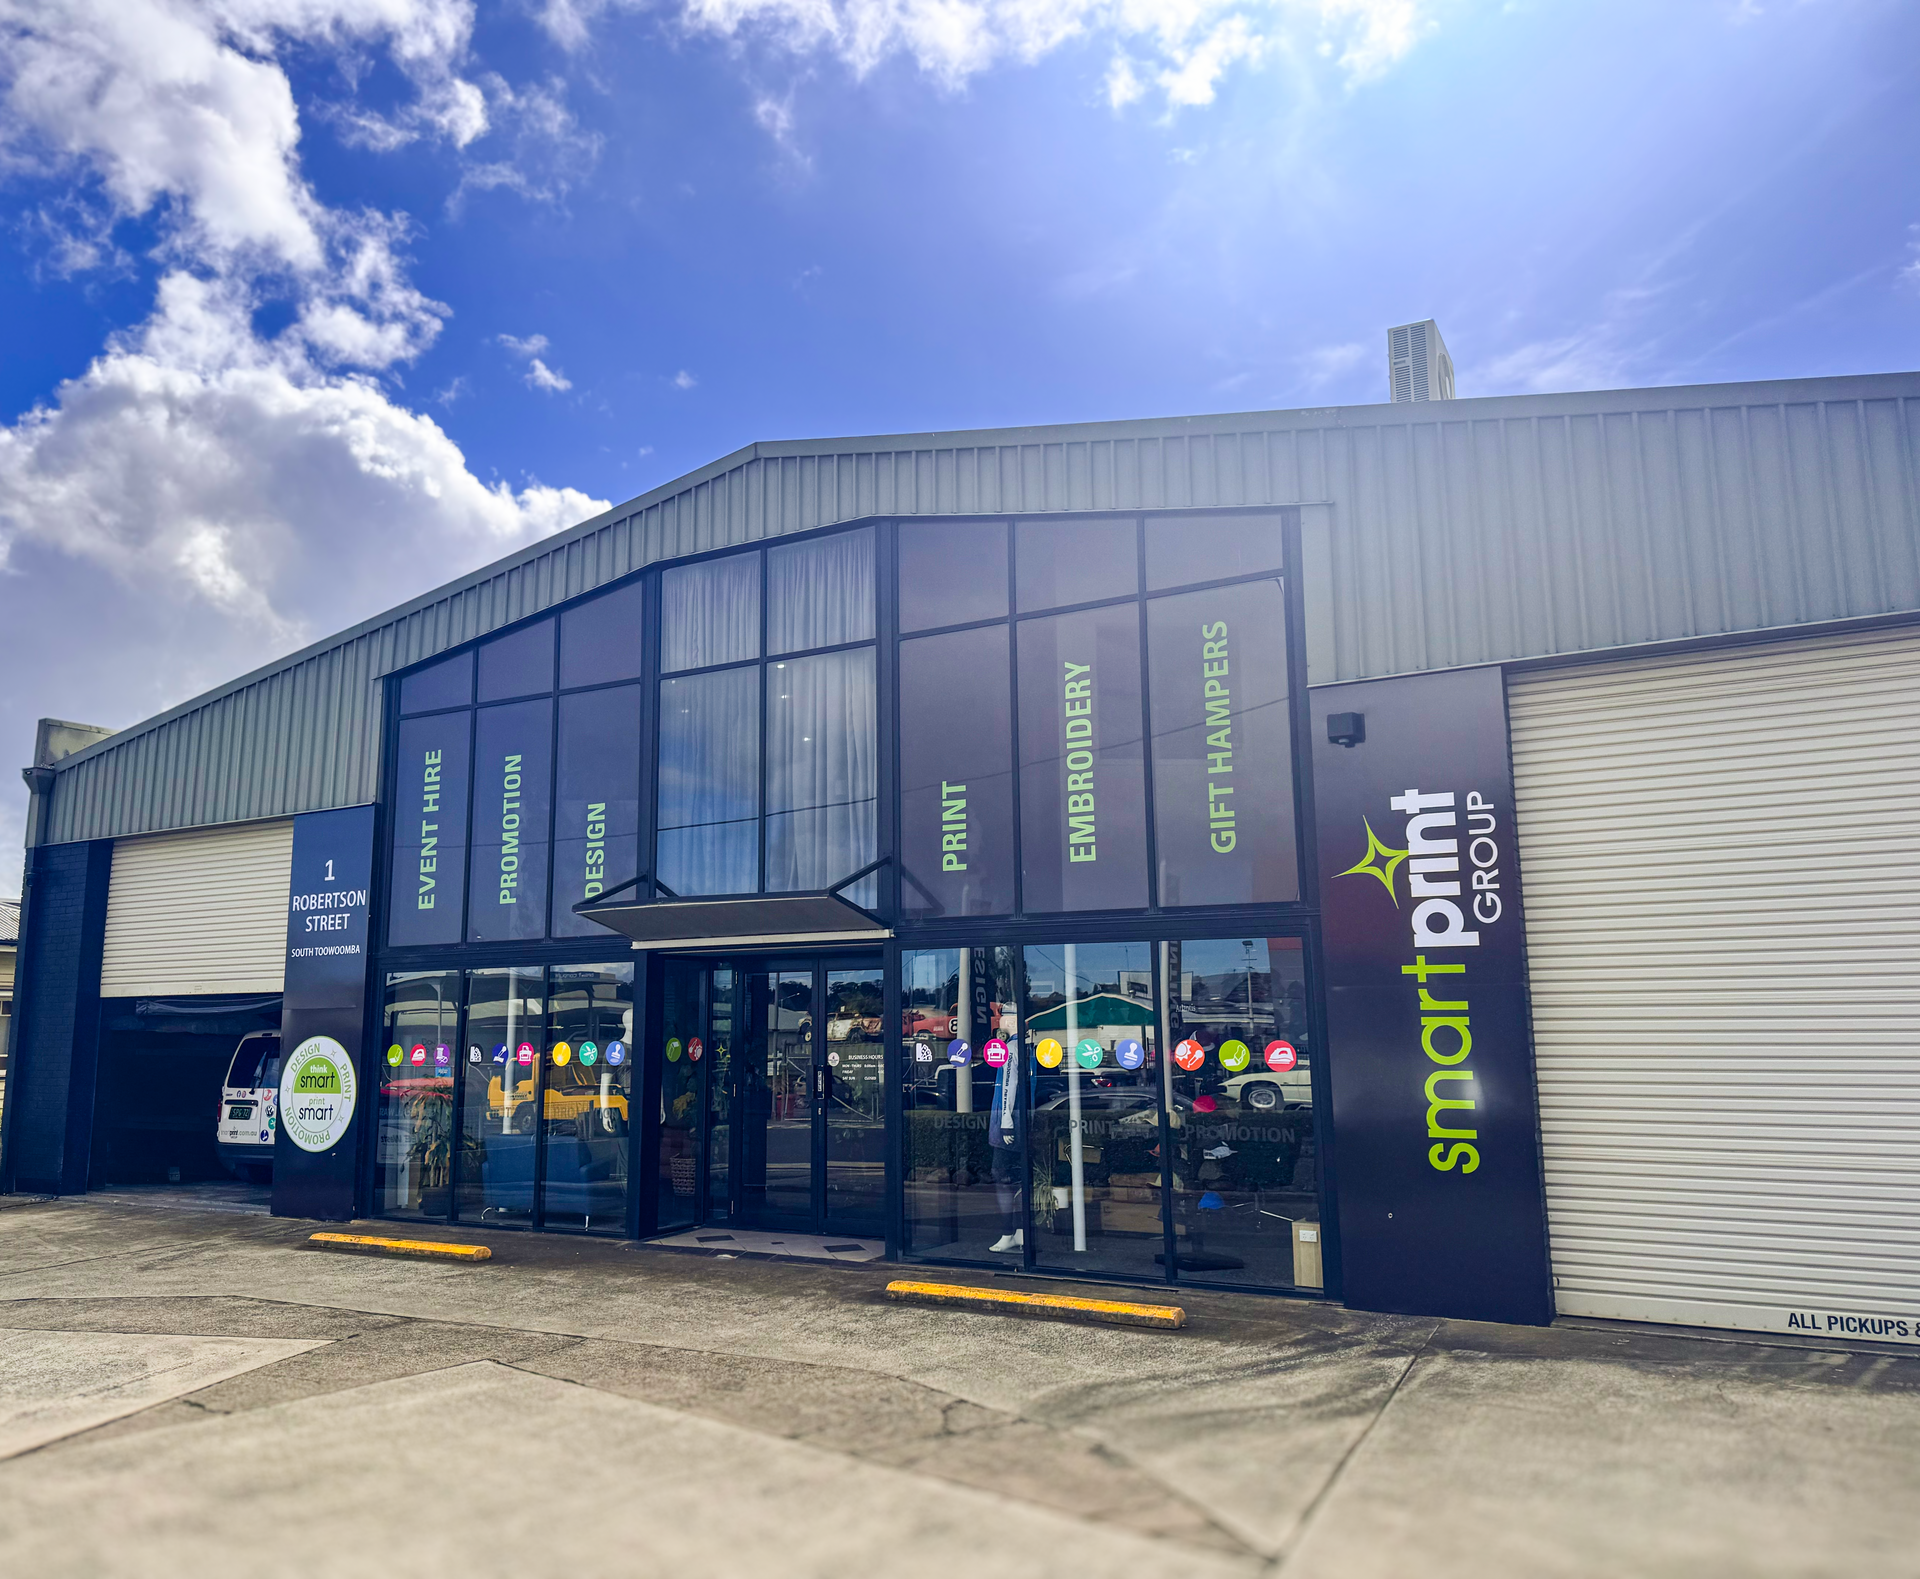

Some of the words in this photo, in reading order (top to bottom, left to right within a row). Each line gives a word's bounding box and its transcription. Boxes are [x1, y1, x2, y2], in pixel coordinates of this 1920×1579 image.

[1202, 620, 1233, 774] HAMPERS
[1064, 661, 1097, 862] EMBROIDERY
[422, 749, 442, 812] HIRE
[499, 754, 522, 905] PROMOTION
[942, 780, 967, 871] PRINT
[1208, 782, 1236, 853] GIFT
[418, 820, 438, 910] EVENT
[584, 802, 606, 899] DESIGN
[1465, 790, 1502, 924] GROUP
[324, 859, 335, 881] 1
[292, 889, 366, 912] ROBERTSON
[305, 913, 351, 932] STREET
[291, 947, 314, 958] SOUTH
[314, 944, 361, 956] TOOWOOMBA
[290, 1043, 321, 1073] DESIGN
[309, 1064, 328, 1073] think
[300, 1072, 335, 1088] smart
[340, 1063, 352, 1103] PRINT
[298, 1104, 334, 1120] smart
[308, 1096, 326, 1107] print
[284, 1106, 331, 1145] PROMOTION
[934, 1115, 987, 1130] DESIGN
[1068, 1119, 1114, 1135] PRINT
[1185, 1124, 1296, 1144] PROMOTION
[1787, 1312, 1822, 1330] ALL
[1827, 1315, 1909, 1337] PICKUPS
